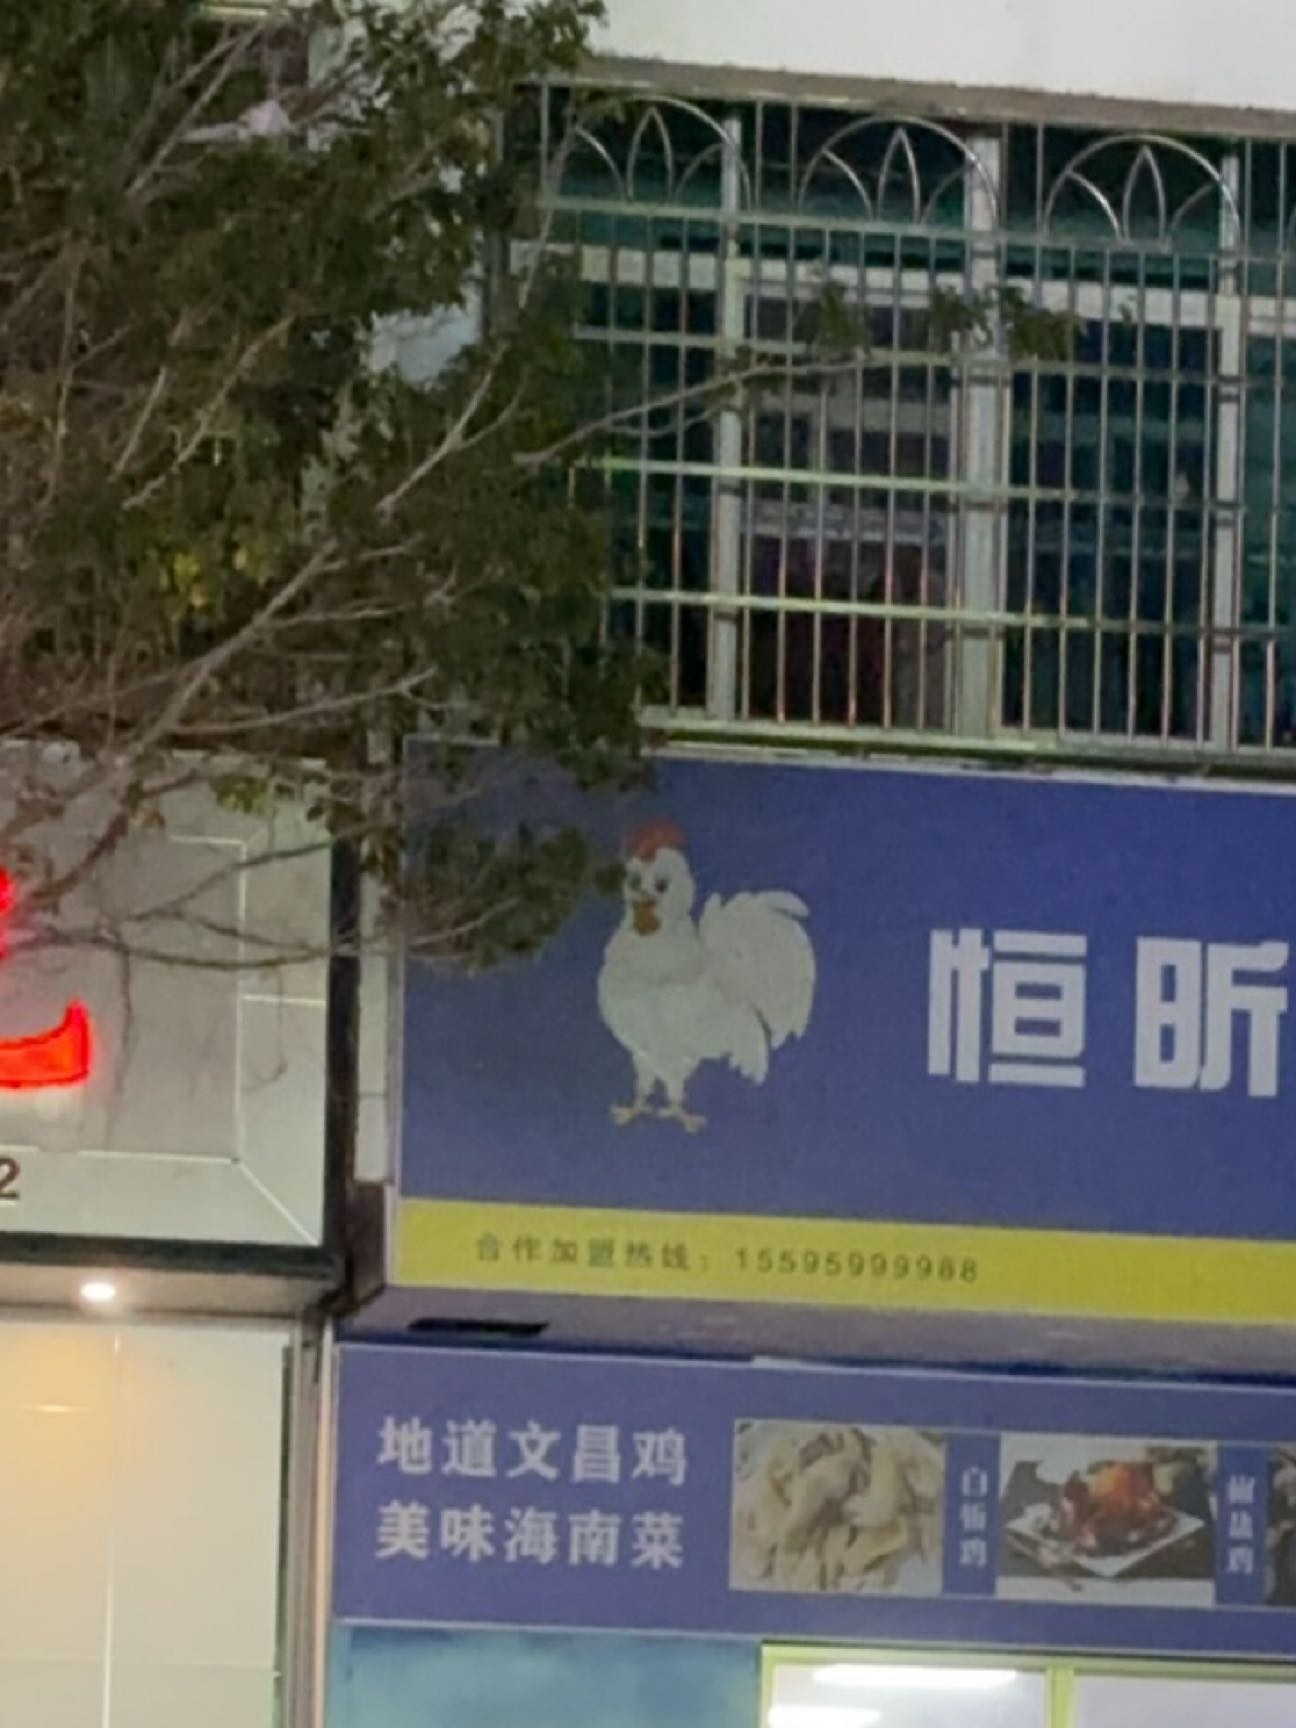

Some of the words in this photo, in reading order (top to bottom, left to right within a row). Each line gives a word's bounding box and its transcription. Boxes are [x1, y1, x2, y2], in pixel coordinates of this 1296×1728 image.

[375, 1414, 689, 1486] 地道文昌鸡
[374, 1499, 686, 1570] 美味海南菜
